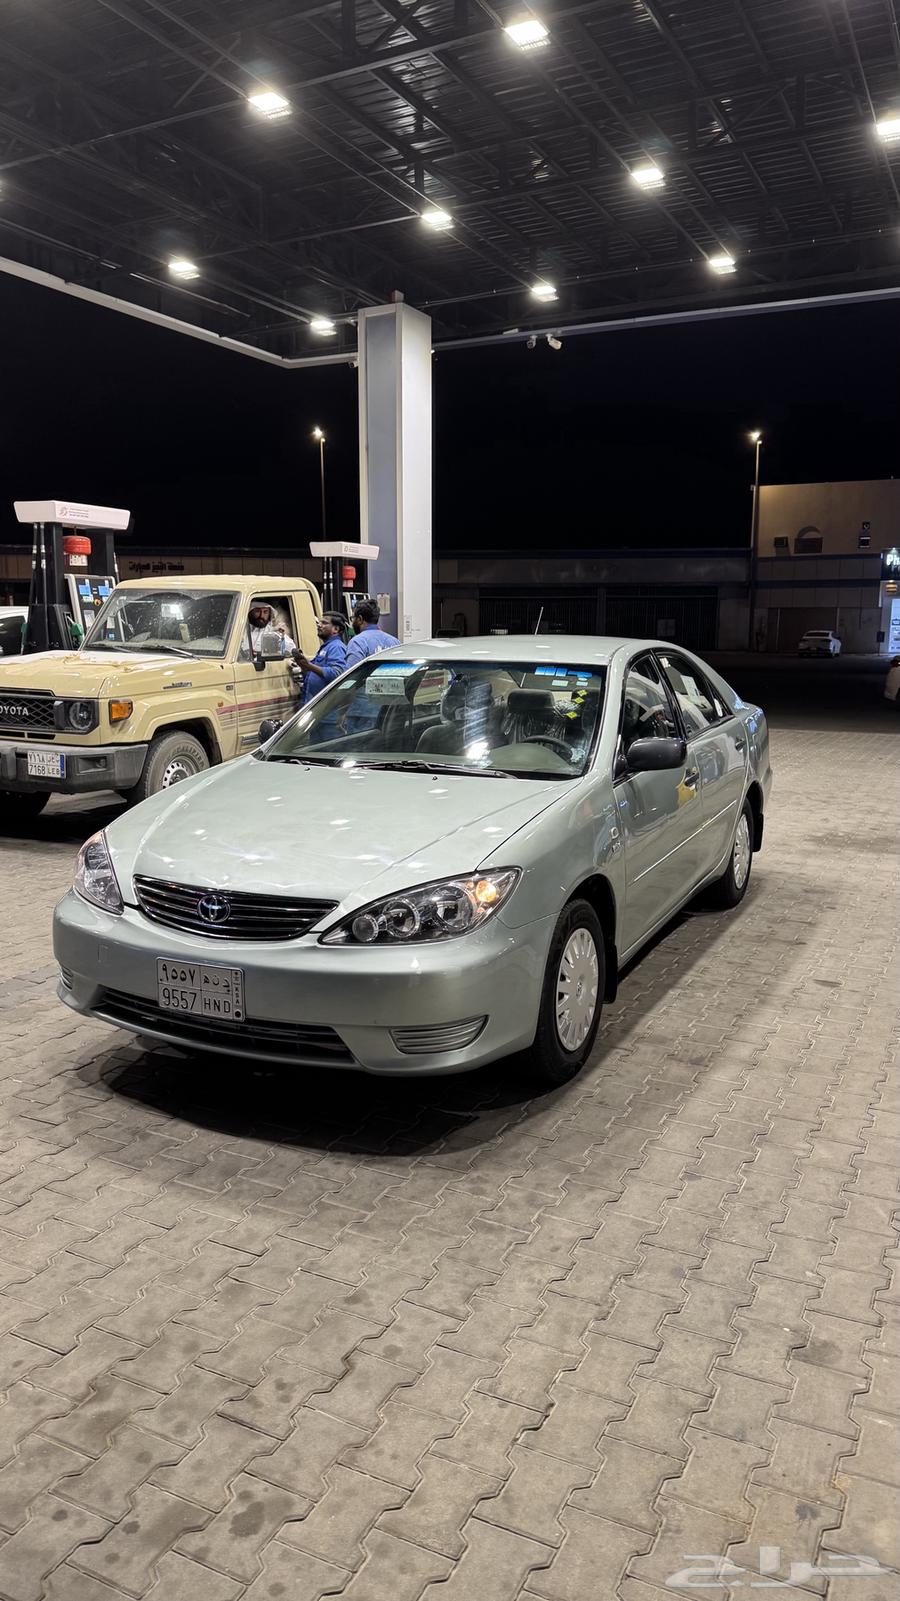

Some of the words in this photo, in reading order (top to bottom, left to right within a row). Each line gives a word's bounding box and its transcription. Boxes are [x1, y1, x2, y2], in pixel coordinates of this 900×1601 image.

[0, 705, 29, 716] OYOTA
[28, 765, 46, 776] 7168
[162, 963, 196, 986] ٩٥٥٧
[162, 987, 197, 1010] 9557
[203, 997, 231, 1013] HND
